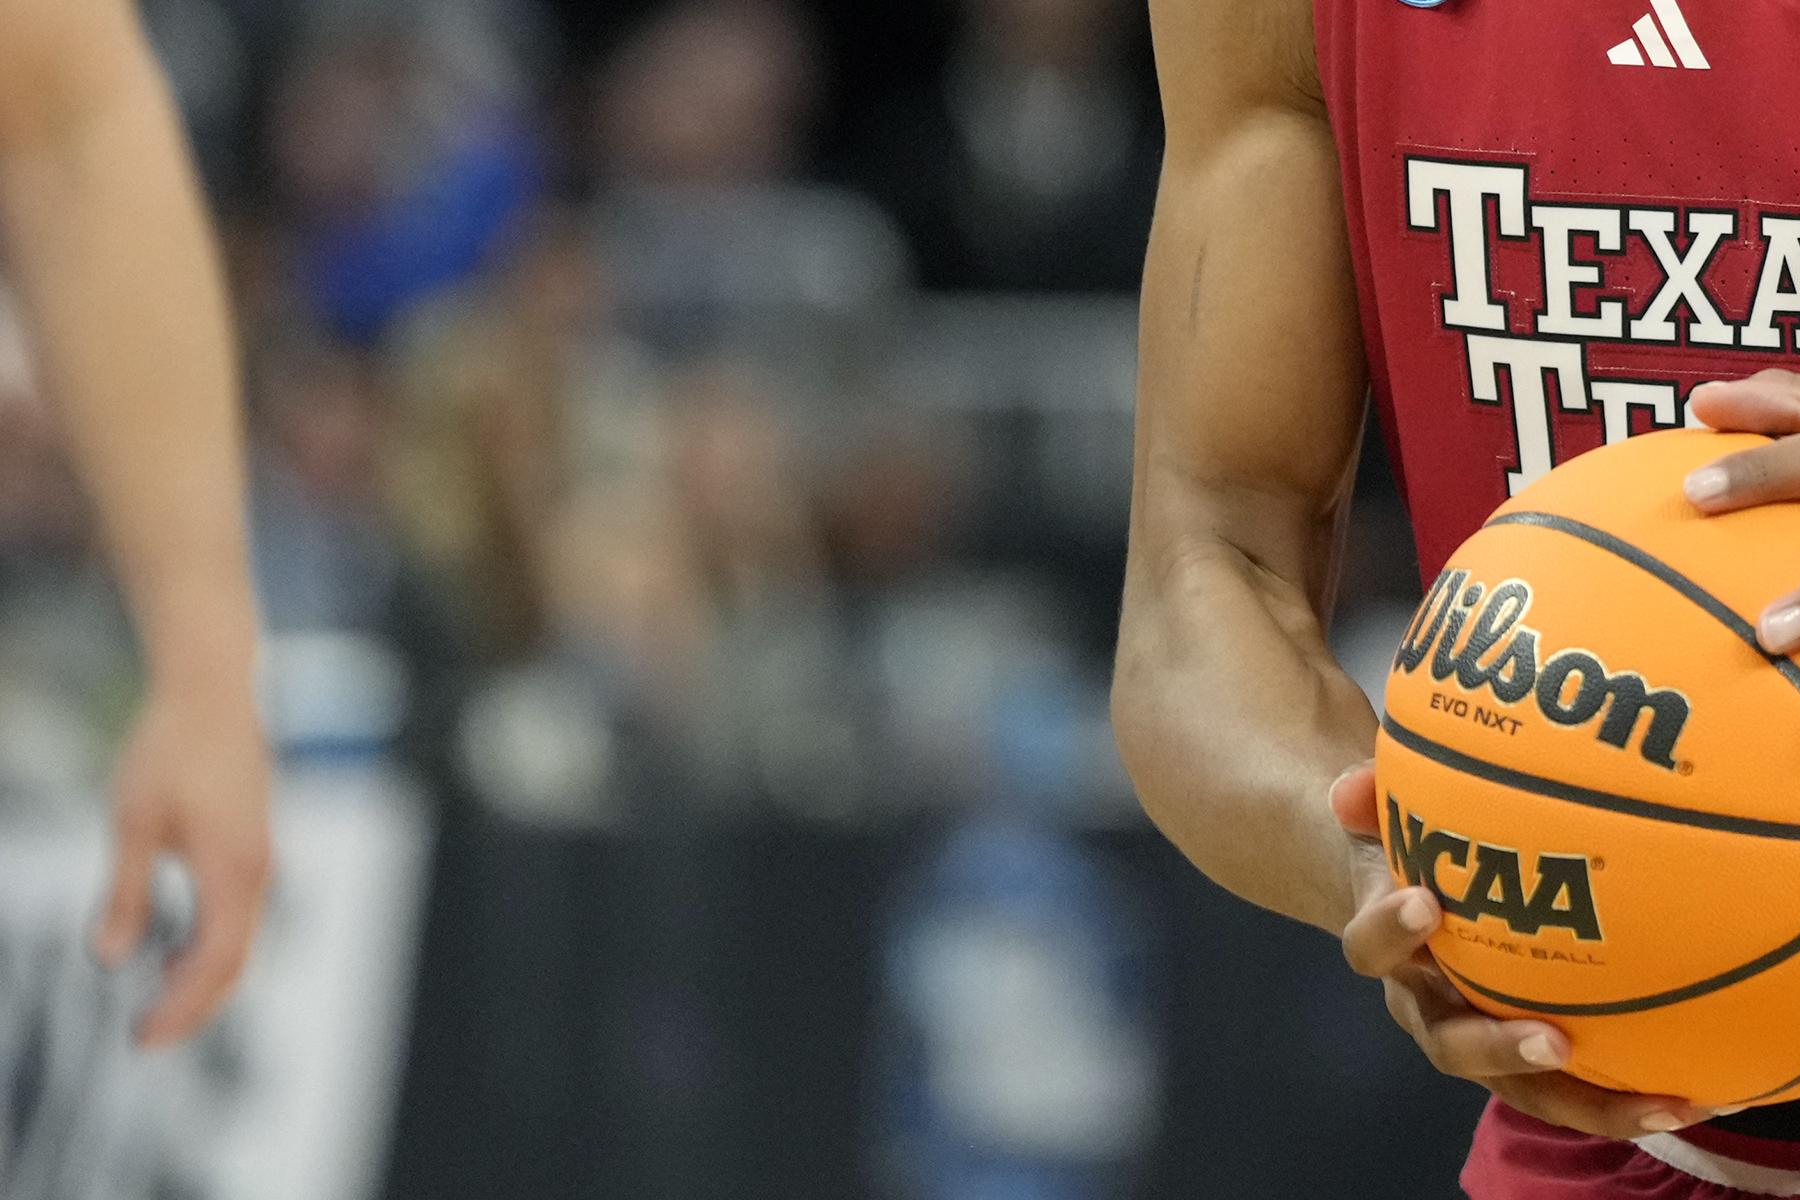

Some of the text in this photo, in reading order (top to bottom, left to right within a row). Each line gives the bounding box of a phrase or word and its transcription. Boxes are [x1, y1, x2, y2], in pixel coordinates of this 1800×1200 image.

[1394, 569, 1688, 770] Wilson
[1430, 692, 1523, 736] EVO NXT
[1387, 792, 1604, 941] NCAA
[1457, 927, 1524, 957] GAME
[1530, 947, 1605, 966] BALL
